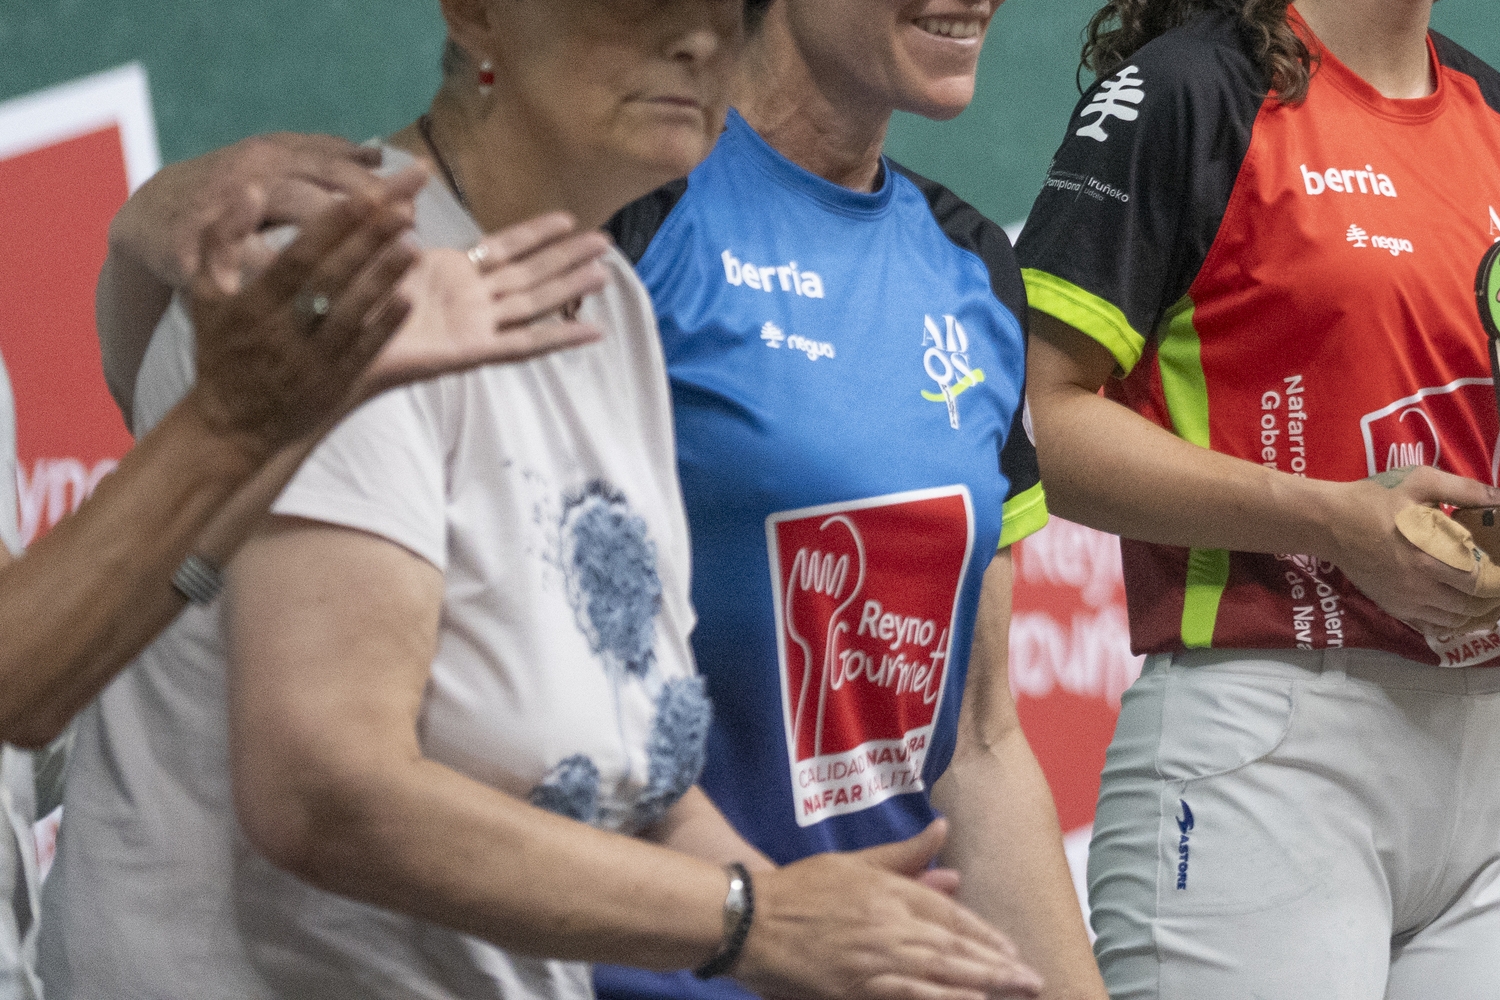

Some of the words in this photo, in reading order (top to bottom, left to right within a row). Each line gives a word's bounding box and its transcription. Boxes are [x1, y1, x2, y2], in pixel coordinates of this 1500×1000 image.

[1087, 176, 1129, 202] Iruñeko
[1299, 163, 1397, 198] berria
[1370, 232, 1414, 256] negua
[720, 249, 825, 299] berria
[787, 333, 836, 361] negua
[1260, 390, 1281, 470] Gober
[1282, 374, 1308, 477] Nafarroa
[1284, 572, 1308, 600] de
[857, 601, 936, 651] Reyno
[1291, 604, 1315, 650] Nava
[1314, 580, 1344, 650] obiern
[829, 621, 950, 706] Gourmet
[799, 754, 866, 789] CALIDAD
[803, 784, 863, 816] NAFAR
